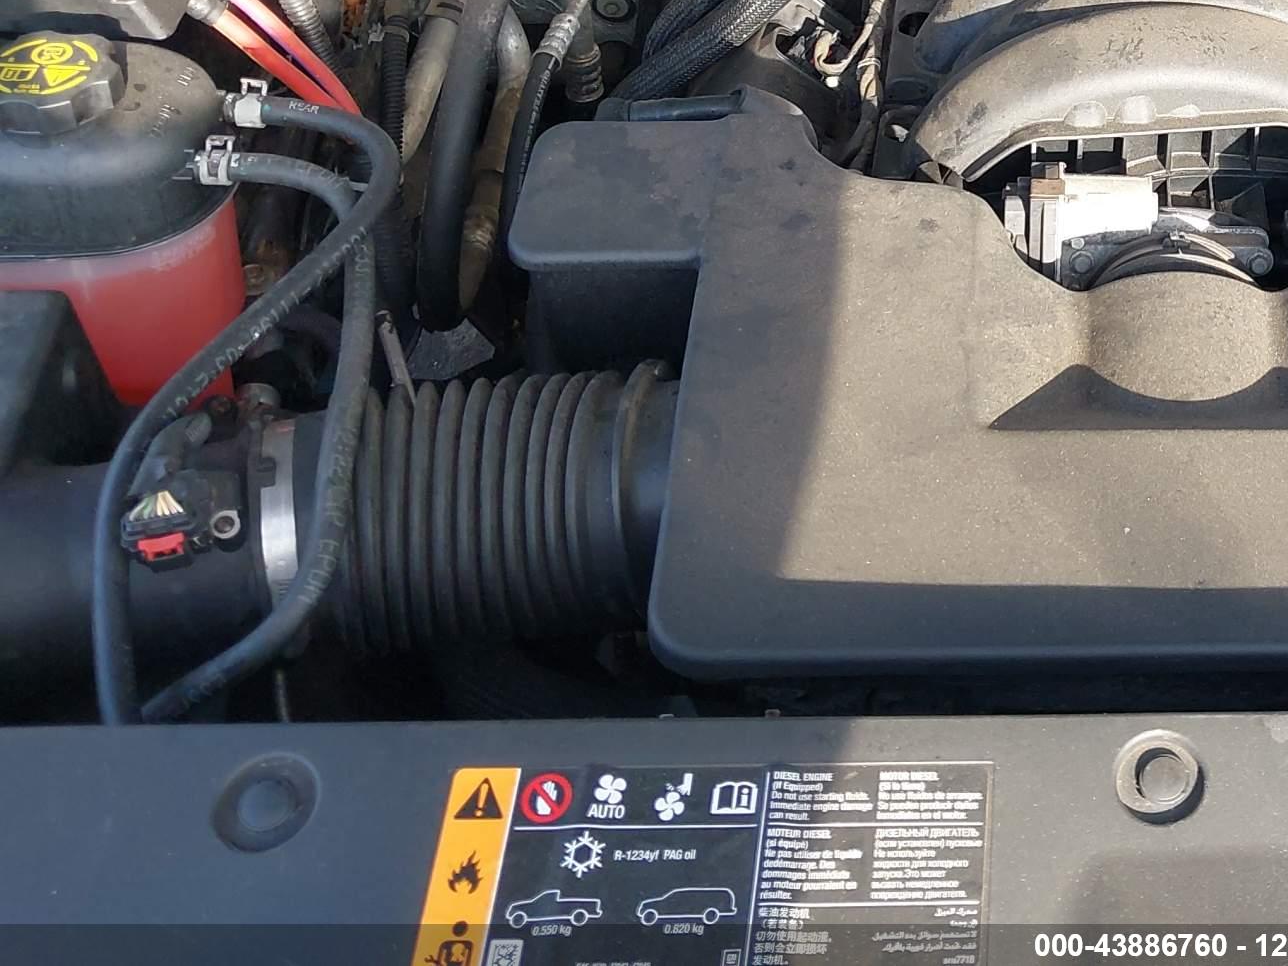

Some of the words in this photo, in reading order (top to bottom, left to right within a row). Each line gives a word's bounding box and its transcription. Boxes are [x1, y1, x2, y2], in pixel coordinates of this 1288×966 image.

[774, 771, 802, 781] DIESEL
[803, 772, 833, 781] ENGINE
[879, 771, 910, 781] MOTOR
[910, 771, 940, 781] DIESEL
[783, 782, 823, 792] Equipped)
[771, 791, 782, 800] Do
[784, 792, 797, 801] not
[798, 793, 812, 801] use
[814, 792, 844, 803] starting
[585, 803, 625, 819] AUTO
[770, 801, 812, 811] Immediate
[813, 802, 840, 812] engine
[840, 802, 873, 812] damage
[785, 812, 810, 821] result.
[767, 828, 801, 838] MOTEUR
[802, 830, 832, 839] DIESEL
[930, 827, 980, 838] ДВИГАТЕЛЬ
[766, 839, 777, 849] (si
[777, 839, 808, 850] équipé)
[614, 849, 660, 863] R-1234yf
[663, 849, 683, 861] PAG
[684, 849, 696, 861] oil
[764, 849, 776, 858] Ne
[777, 850, 792, 859] pas
[794, 850, 821, 859] utiliser
[822, 849, 834, 859] de
[819, 860, 836, 869] Des
[762, 869, 807, 880] dommages
[760, 881, 771, 889] au
[773, 881, 801, 890] moteur
[759, 891, 792, 899] résulter.
[758, 907, 809, 919] 柴油发动机
[532, 925, 558, 936] 0.550
[559, 924, 572, 936] kg
[692, 923, 704, 936] kg
